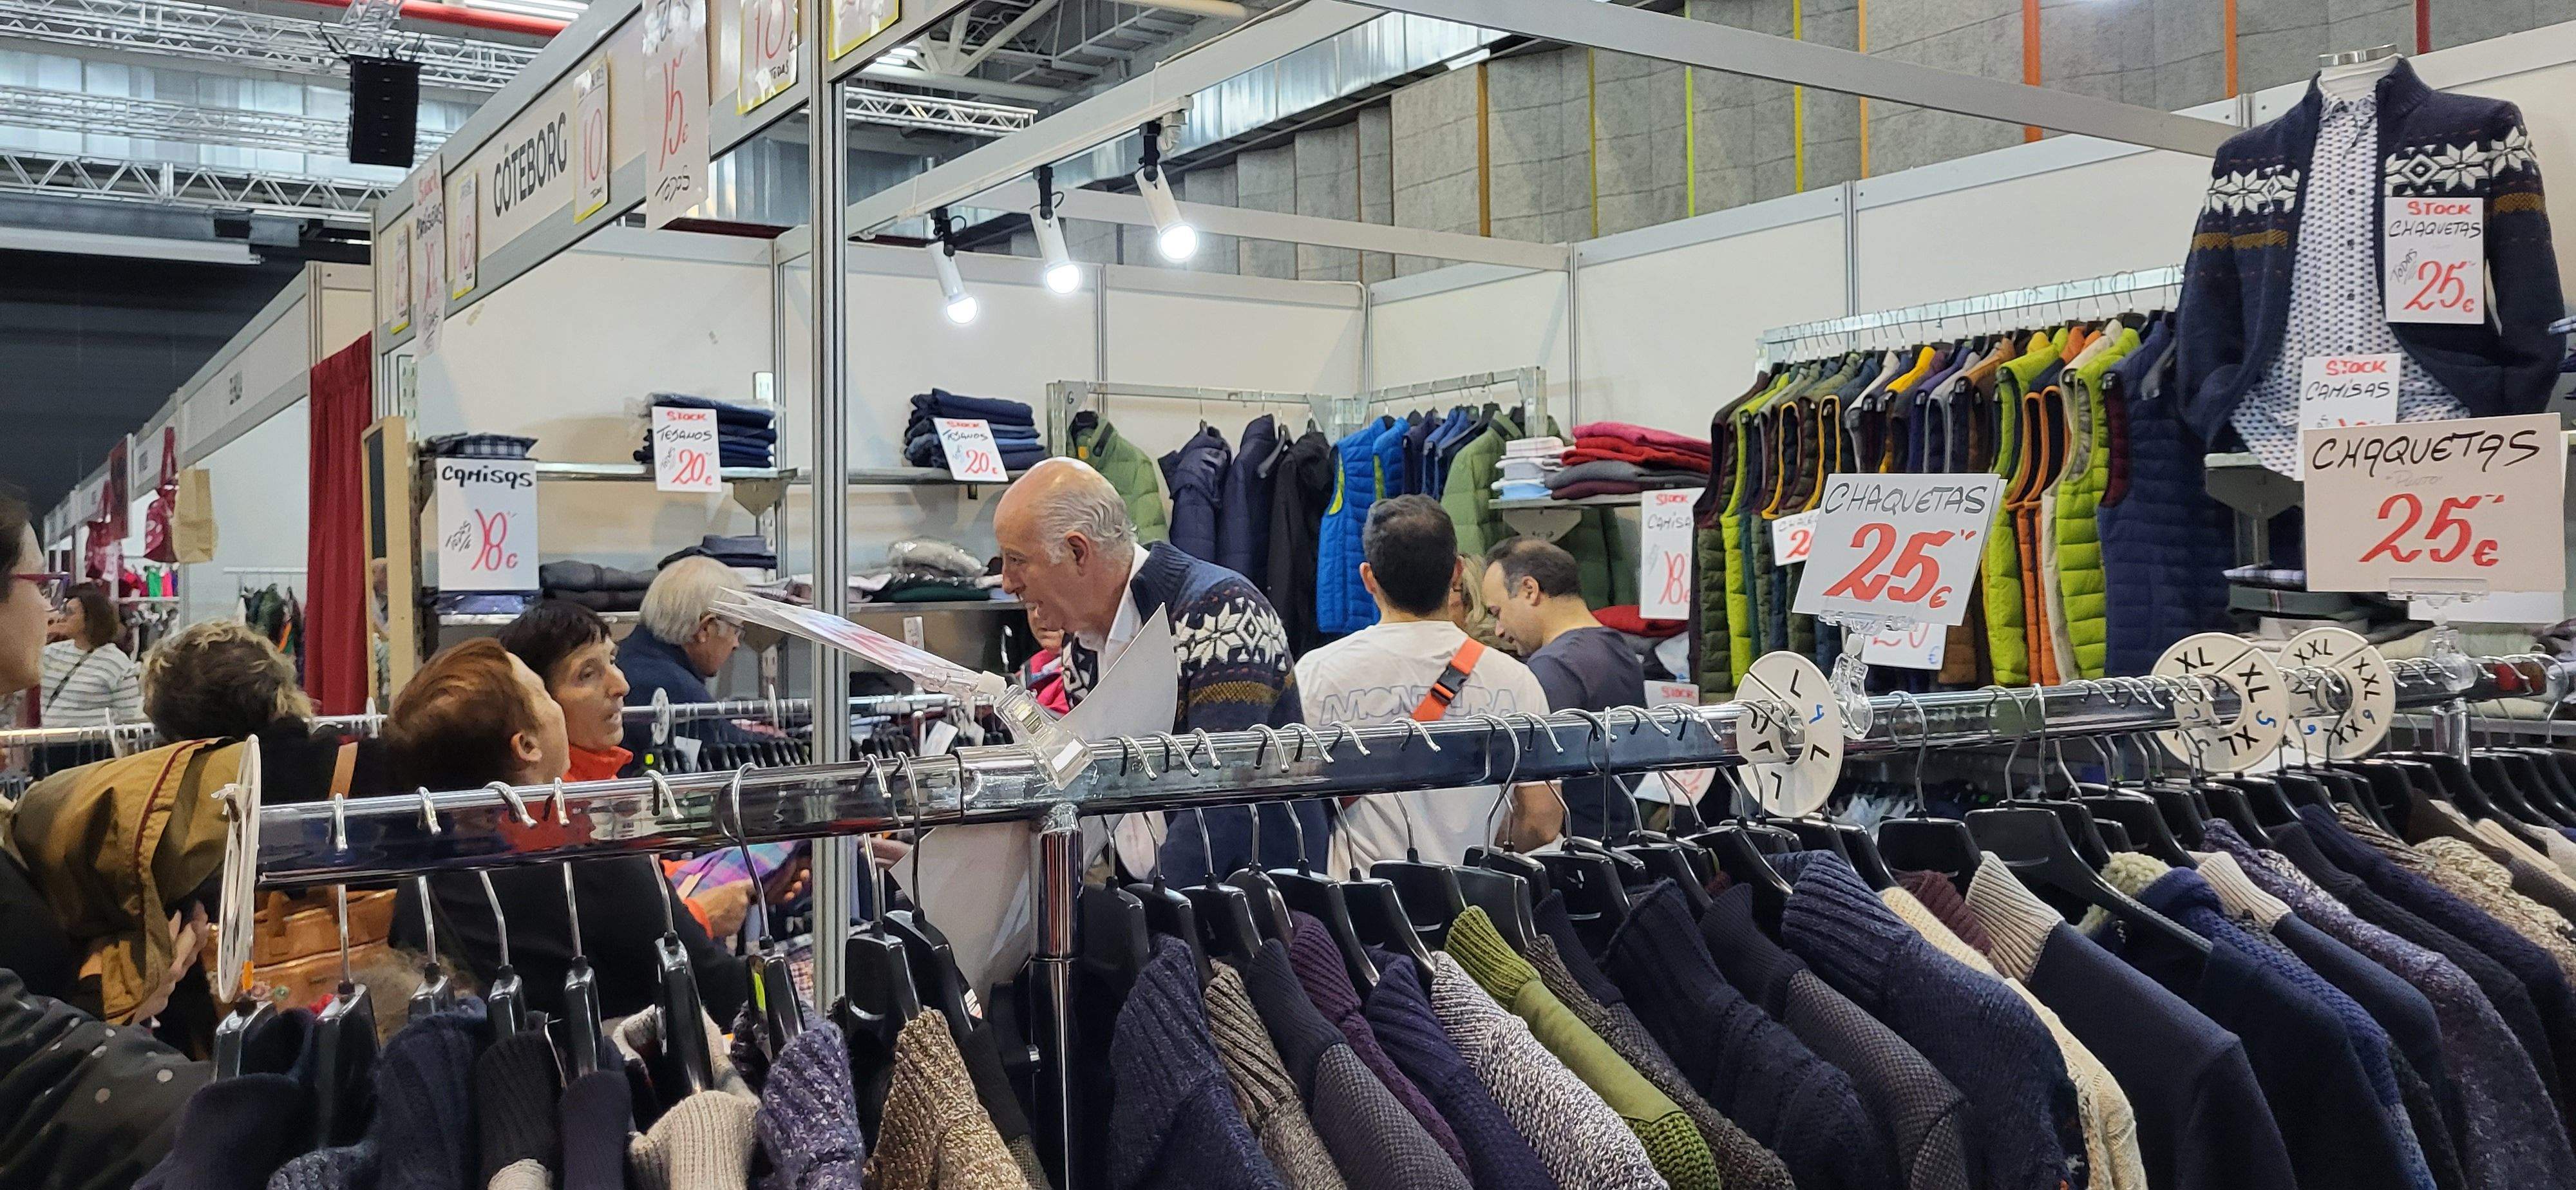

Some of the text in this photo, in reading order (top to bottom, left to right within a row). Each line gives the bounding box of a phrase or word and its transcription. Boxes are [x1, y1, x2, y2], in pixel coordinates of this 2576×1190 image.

[494, 111, 567, 218] GÖTEBORG
[2407, 200, 2472, 216] STOCK
[2389, 220, 2481, 240] CHAQUETAS
[2325, 359, 2387, 376] STOCK
[2306, 377, 2391, 401] CAMISAS
[667, 410, 706, 421] STOCK
[656, 424, 712, 442] TEJANOS
[2312, 430, 2541, 478] CHAQUETAS
[1824, 482, 1989, 516] CHAQUETAS
[1647, 511, 1692, 531] CAMISA
[1785, 529, 1814, 559] 2
[2174, 647, 2215, 674] XL
[2293, 638, 2334, 666] XXL
[1790, 668, 1801, 699] L
[2237, 662, 2271, 703] XL
[2352, 656, 2381, 701] XXL
[1810, 743, 1830, 762] L
[2218, 724, 2262, 757] XL
[1771, 771, 1783, 800] L
